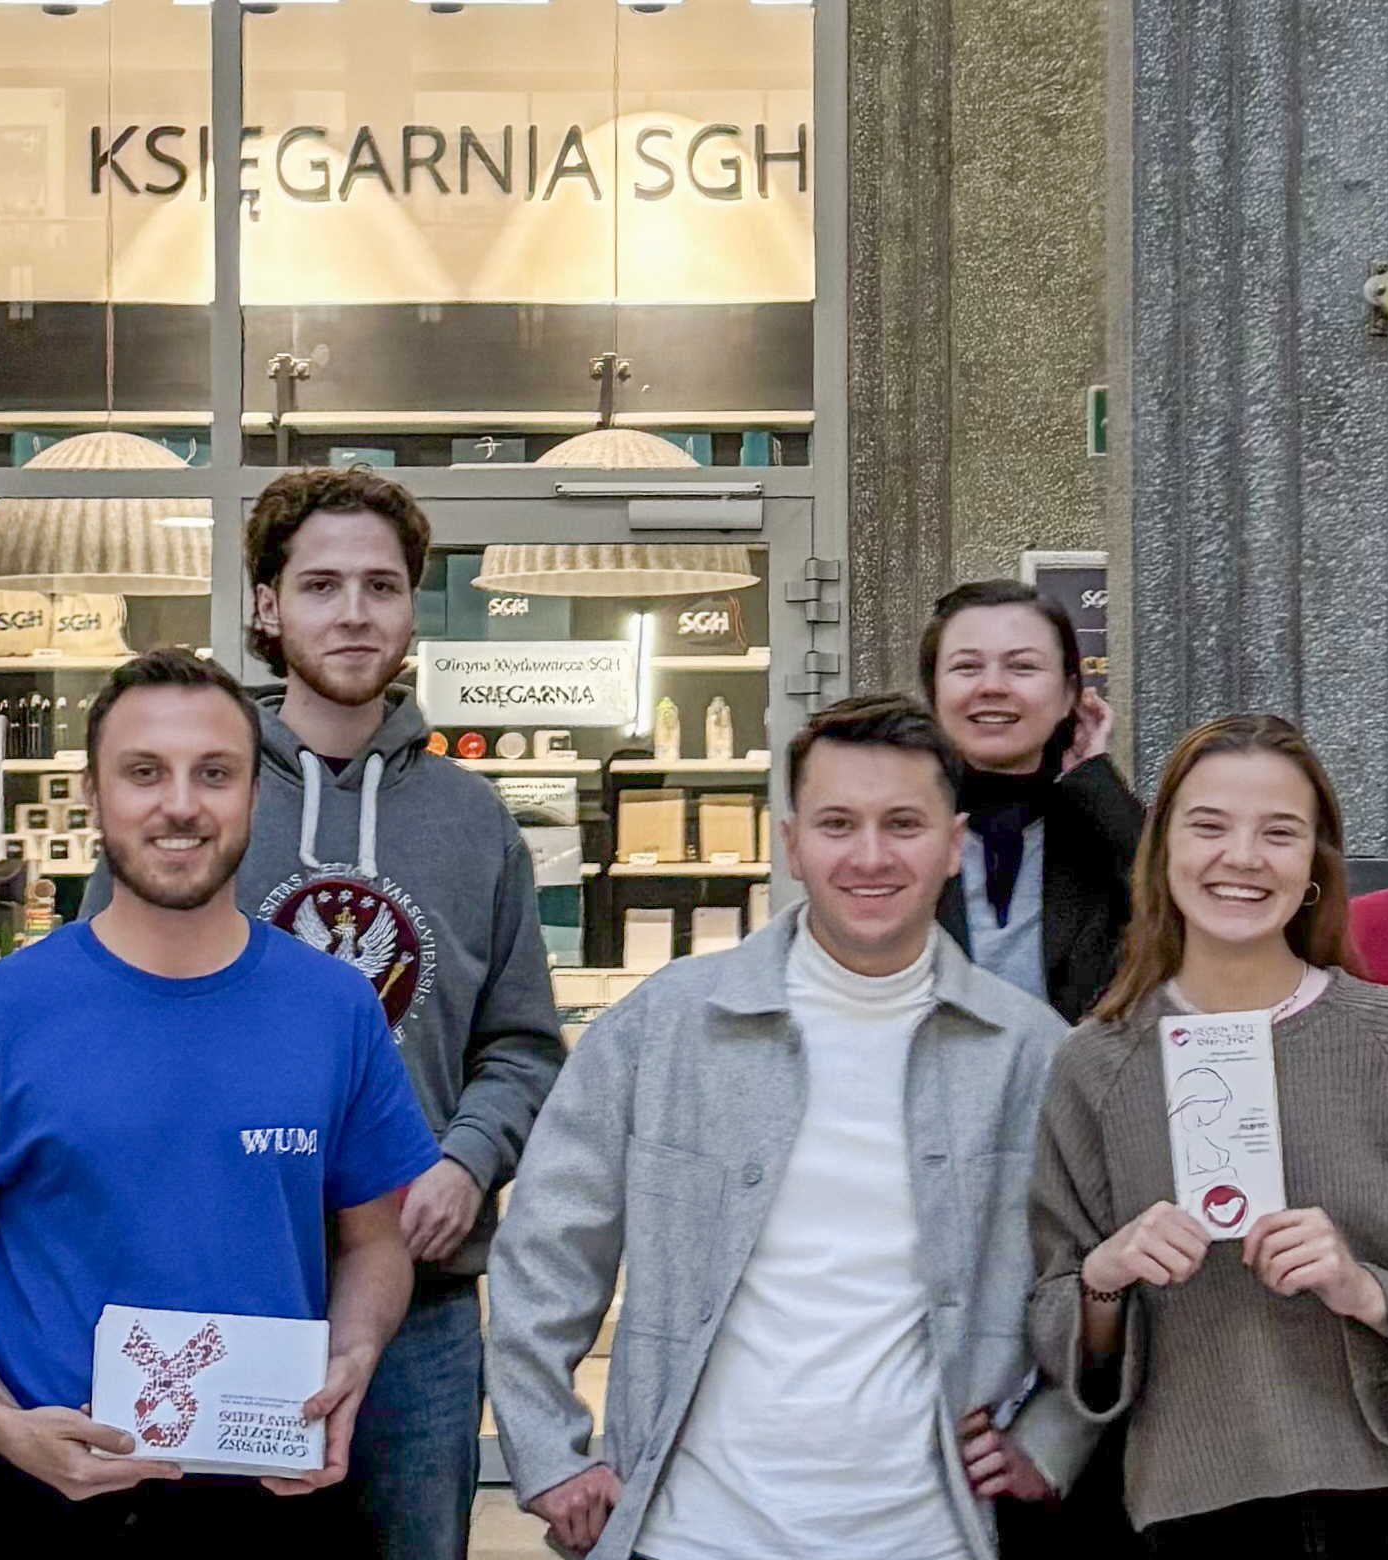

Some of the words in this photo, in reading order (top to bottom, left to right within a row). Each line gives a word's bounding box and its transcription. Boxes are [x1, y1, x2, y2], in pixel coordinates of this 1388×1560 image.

[89, 121, 602, 222] KSIĘGARNIA
[634, 120, 808, 201] SGH
[487, 597, 530, 617] SGH
[57, 611, 102, 633] SGH
[678, 610, 731, 635] SGH
[459, 685, 596, 708] KSIĘGARNIA
[239, 1127, 318, 1155] WUM
